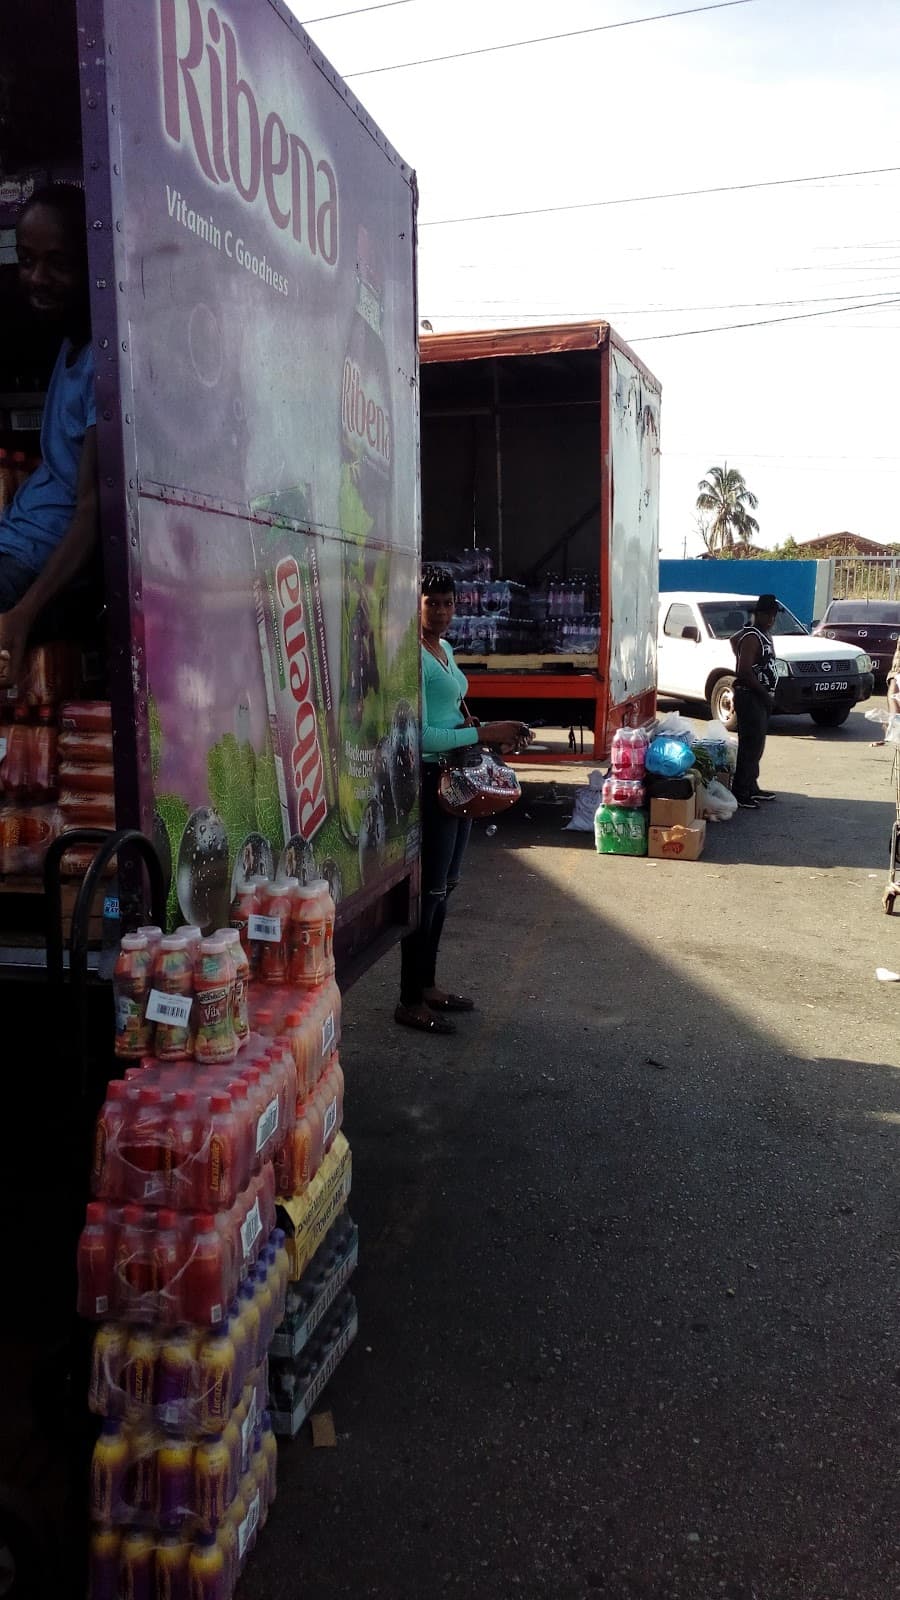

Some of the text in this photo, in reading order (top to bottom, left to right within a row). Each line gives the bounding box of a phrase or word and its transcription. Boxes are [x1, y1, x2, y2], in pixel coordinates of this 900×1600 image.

[159, 0, 337, 266] Ribena
[166, 184, 289, 297] Vitamin C Goodness
[342, 360, 391, 461] Ribena
[276, 556, 327, 840] Ribena
[320, 624, 333, 711] Blackcurrant
[814, 681, 848, 692] TCD 6710
